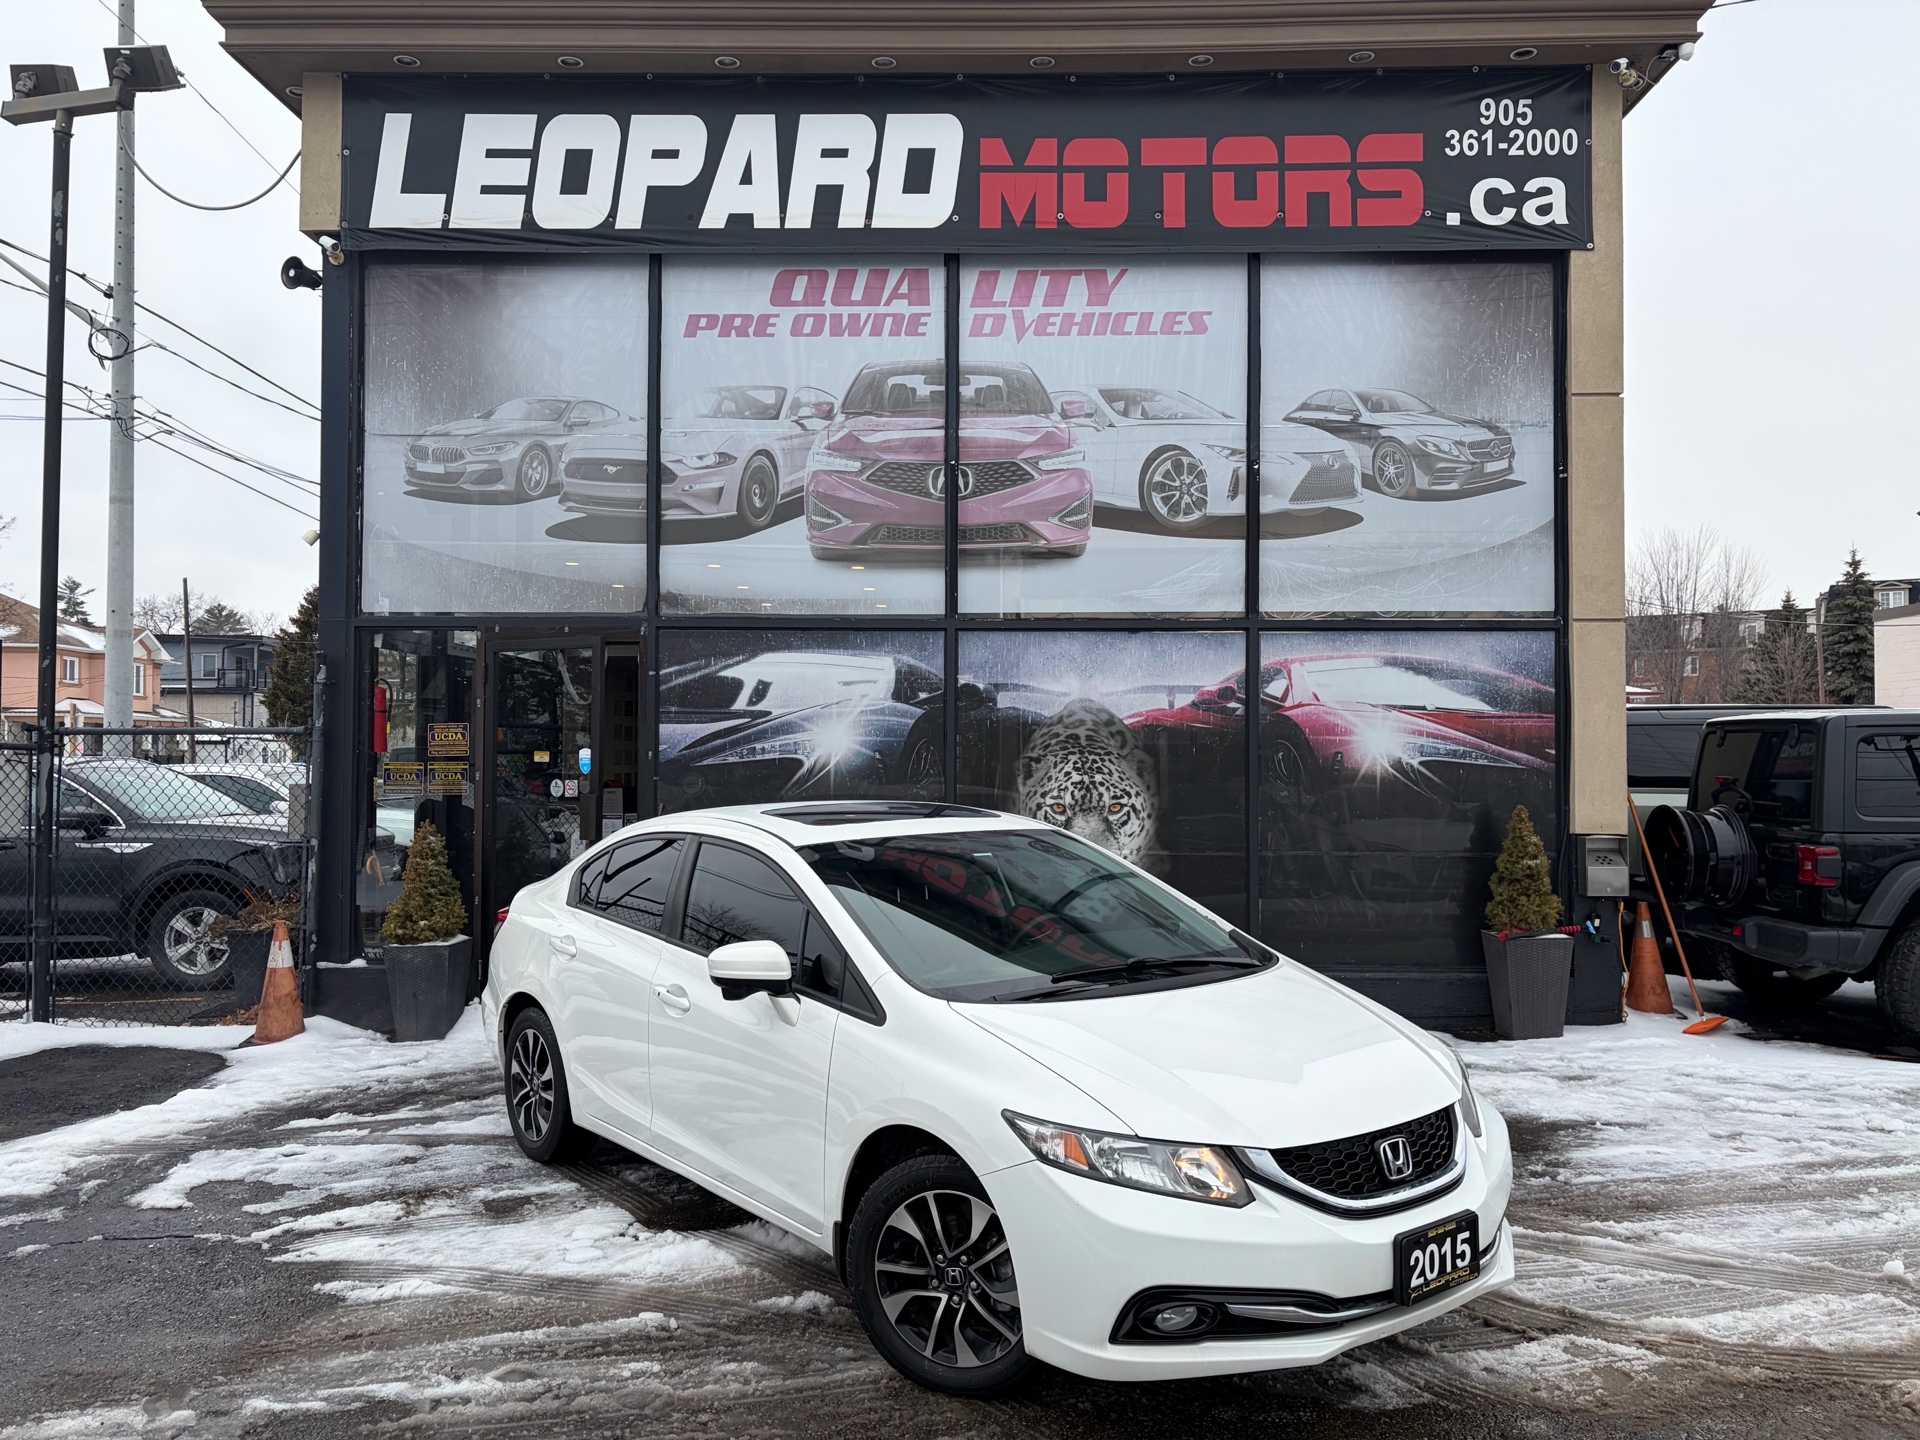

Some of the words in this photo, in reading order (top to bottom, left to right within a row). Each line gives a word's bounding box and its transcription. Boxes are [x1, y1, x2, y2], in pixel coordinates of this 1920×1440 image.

[1479, 98, 1534, 126] 905
[1444, 129, 1579, 157] 361-2000
[368, 112, 964, 231] LEOPARD
[979, 132, 1425, 229] MOTORS
[1445, 175, 1570, 227] .ca
[769, 268, 931, 307] QUA
[969, 268, 1129, 308] LITY
[683, 313, 780, 338] PRE
[433, 732, 463, 741] UCDA
[390, 772, 418, 781] UCDA
[434, 772, 463, 780] UCDA
[1409, 1230, 1472, 1288] 2015
[1422, 1266, 1470, 1292] LEOPARD
